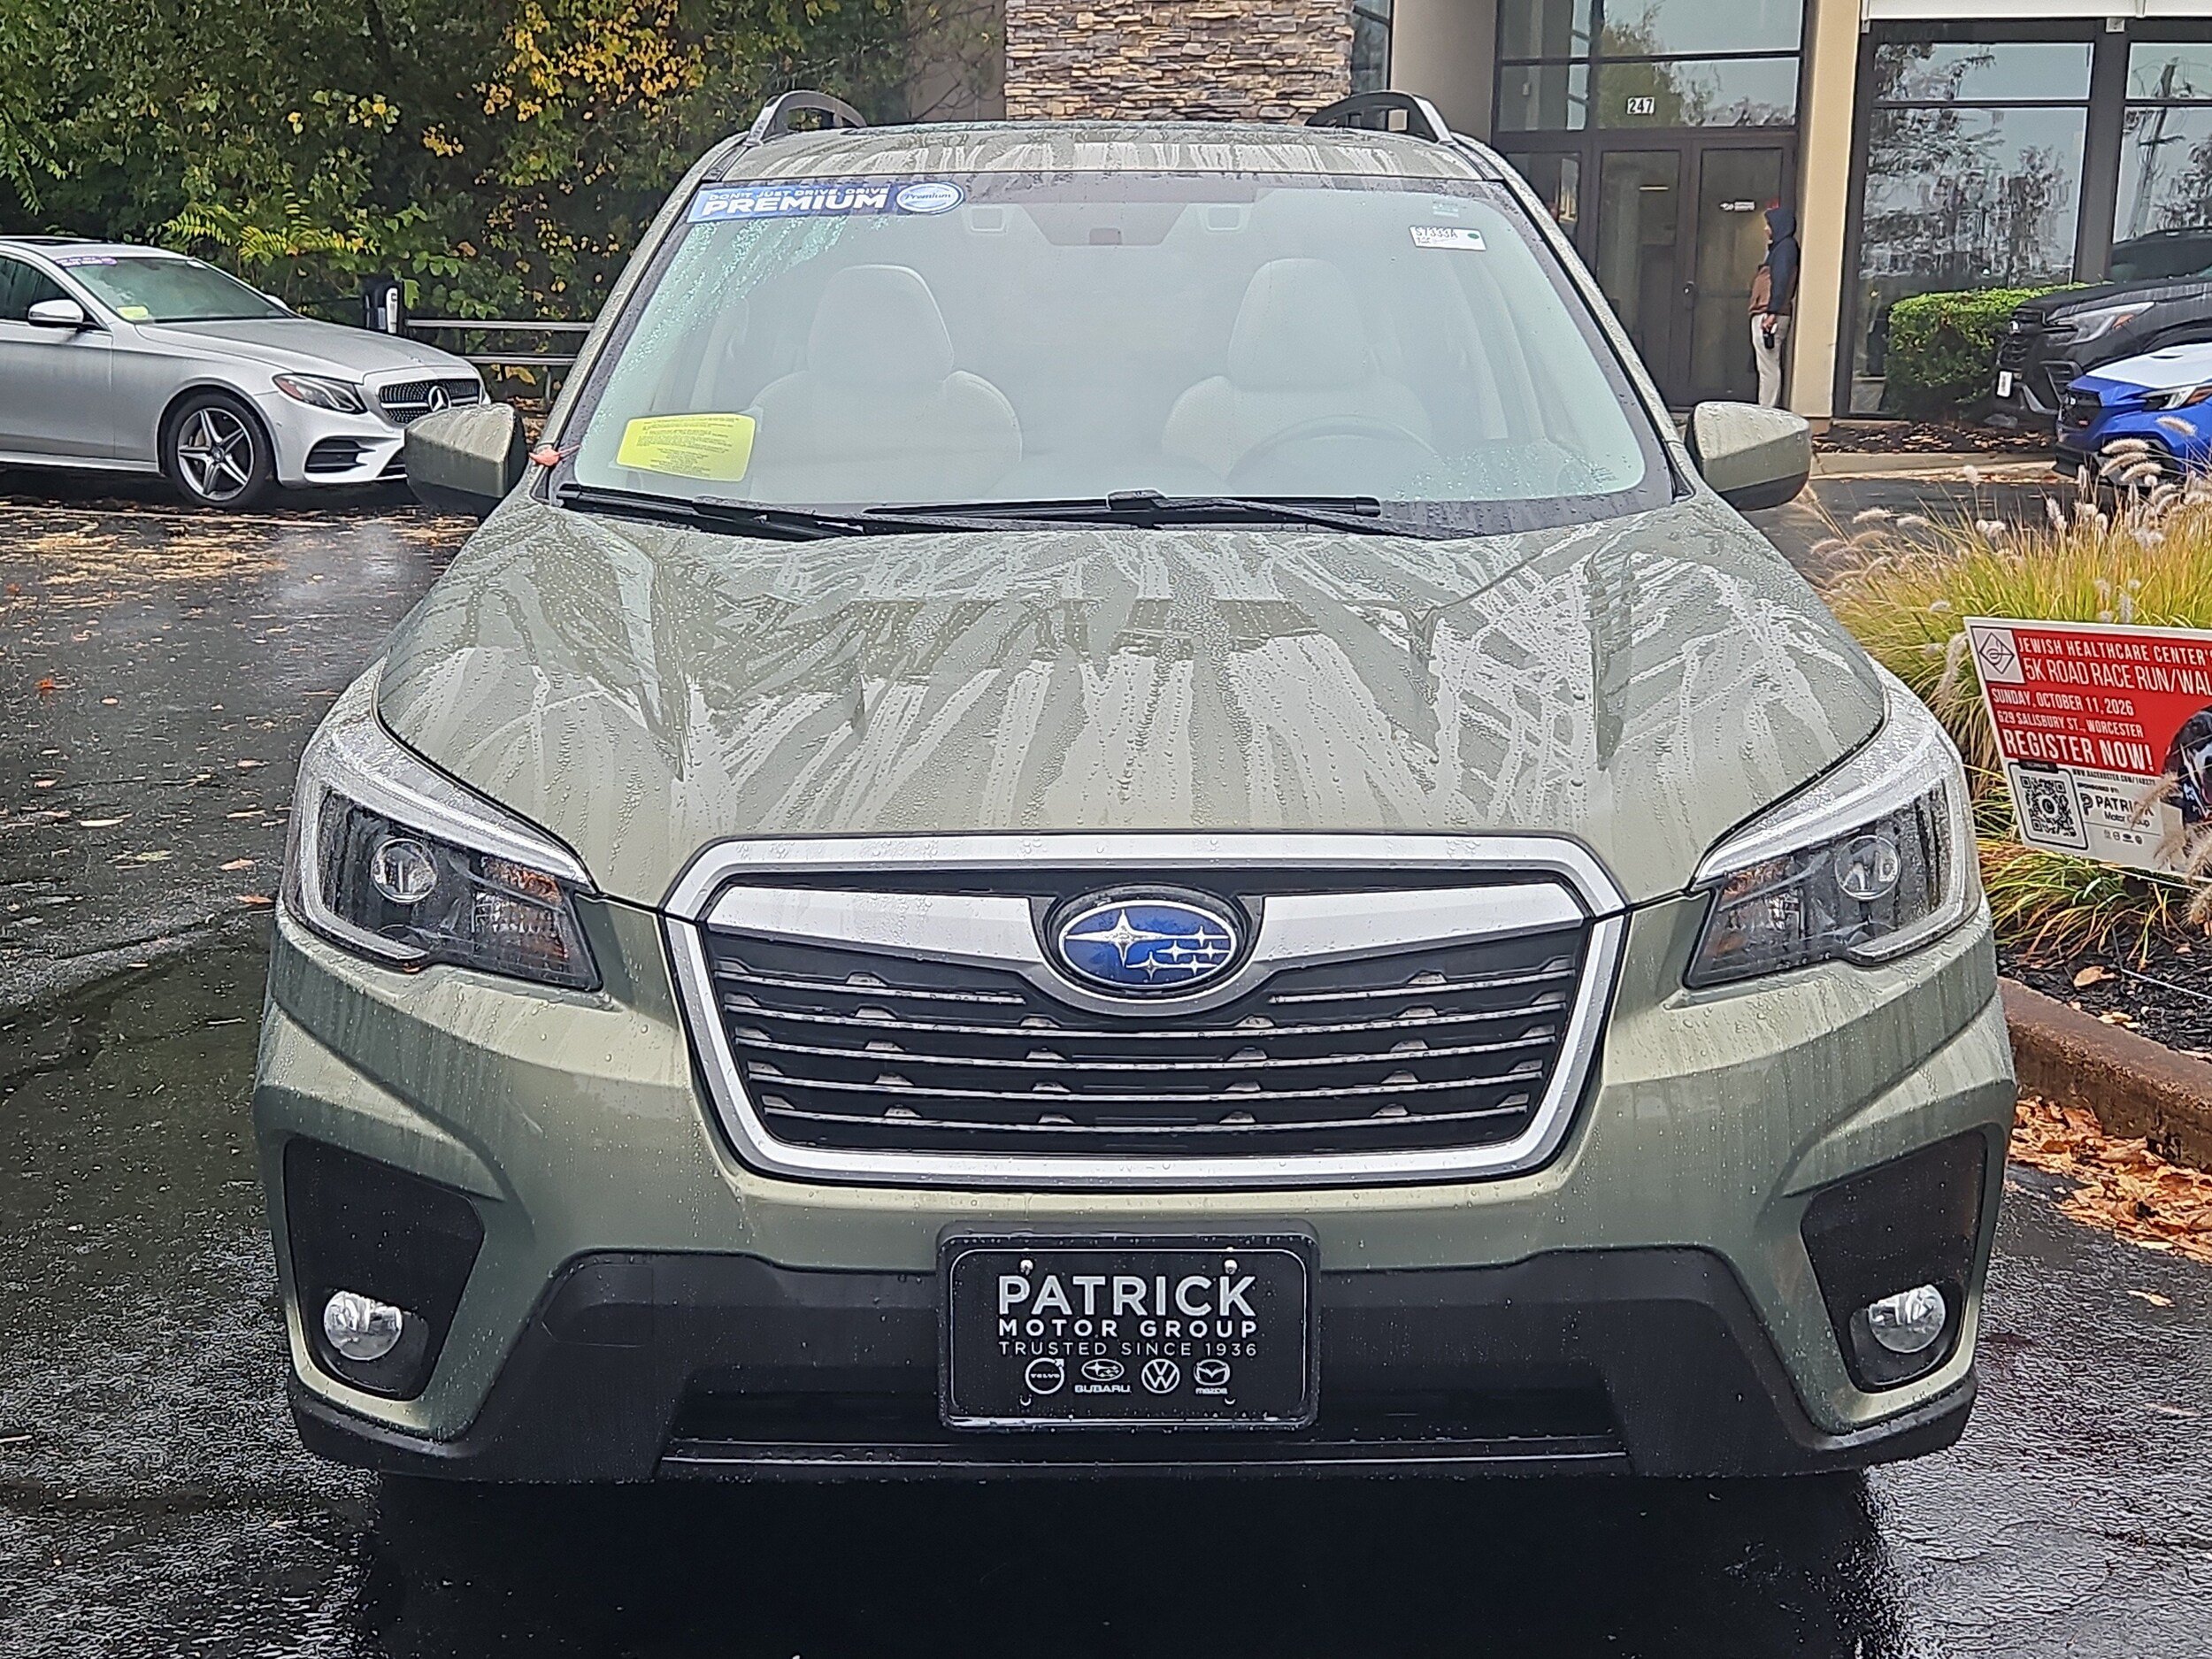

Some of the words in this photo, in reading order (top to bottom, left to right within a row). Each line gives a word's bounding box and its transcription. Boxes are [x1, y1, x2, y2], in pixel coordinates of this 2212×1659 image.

[1629, 99, 1654, 111] 247
[701, 193, 887, 216] PREMIUM
[708, 191, 753, 201] DON'T
[756, 189, 791, 198] JUST
[845, 185, 889, 195] DRIVE
[903, 191, 952, 202] Premium
[2018, 637, 2062, 657] JEWISH
[2065, 640, 2149, 662] HEALTHCARE
[2025, 657, 2045, 681] 5K
[2047, 659, 2089, 686] ROAD
[2093, 662, 2135, 689] RACE
[1991, 687, 2036, 709] SUNDAY,
[2036, 691, 2082, 711] OCTOBER
[2085, 696, 2104, 715] 11,
[2105, 698, 2134, 717] 2026
[1997, 710, 2015, 725] 629
[2015, 710, 2064, 729] SALISBURY
[2085, 719, 2144, 739] WORCESTER
[2002, 728, 2096, 764] REGISTER
[2099, 740, 2155, 772] NOW!
[998, 1275, 1256, 1317] PATRICK
[999, 1319, 1118, 1338] MOTOR
[1140, 1319, 1256, 1338] GROUP
[999, 1341, 1107, 1356] TRUSTED
[1120, 1342, 1191, 1356] SINCE
[1205, 1342, 1256, 1356] 1936
